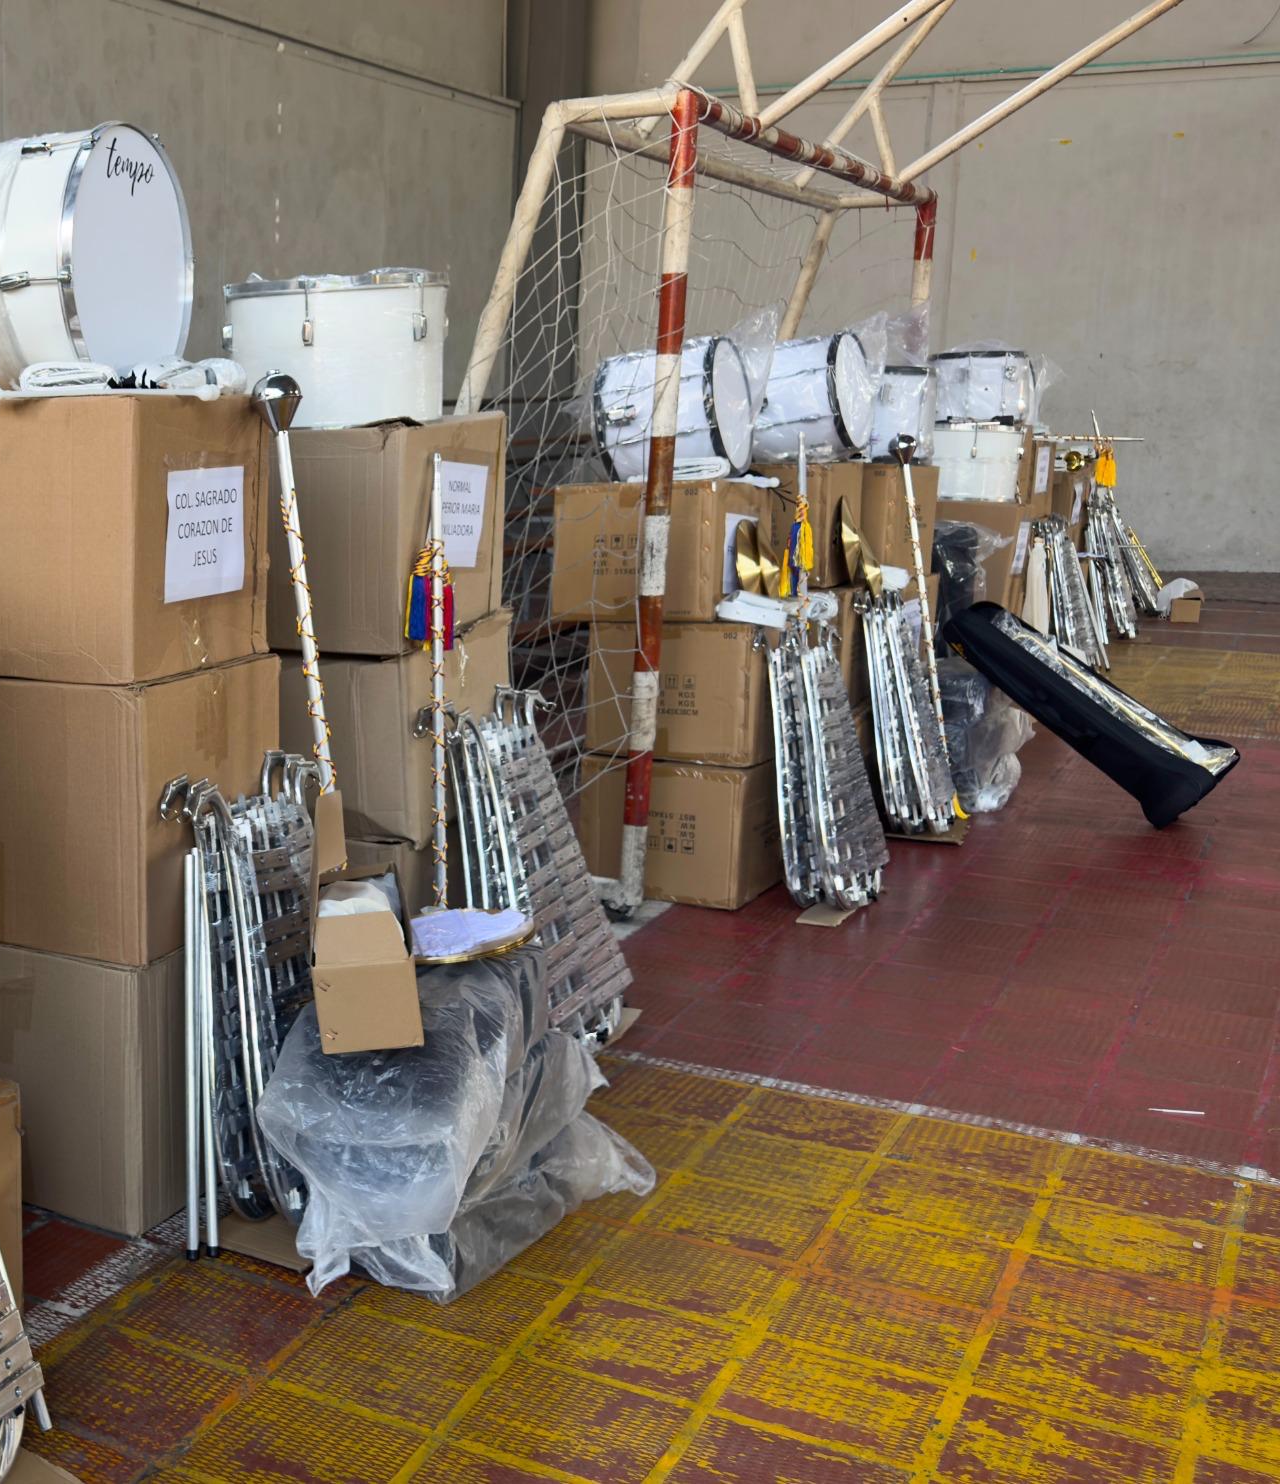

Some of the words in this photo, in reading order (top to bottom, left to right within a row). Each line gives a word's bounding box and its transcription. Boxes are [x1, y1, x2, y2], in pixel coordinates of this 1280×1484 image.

[105, 137, 155, 197] tempo
[195, 488, 237, 507] SAGRADO
[178, 520, 219, 540] CORAZON
[221, 517, 233, 533] DE
[193, 548, 217, 567] JESUS
